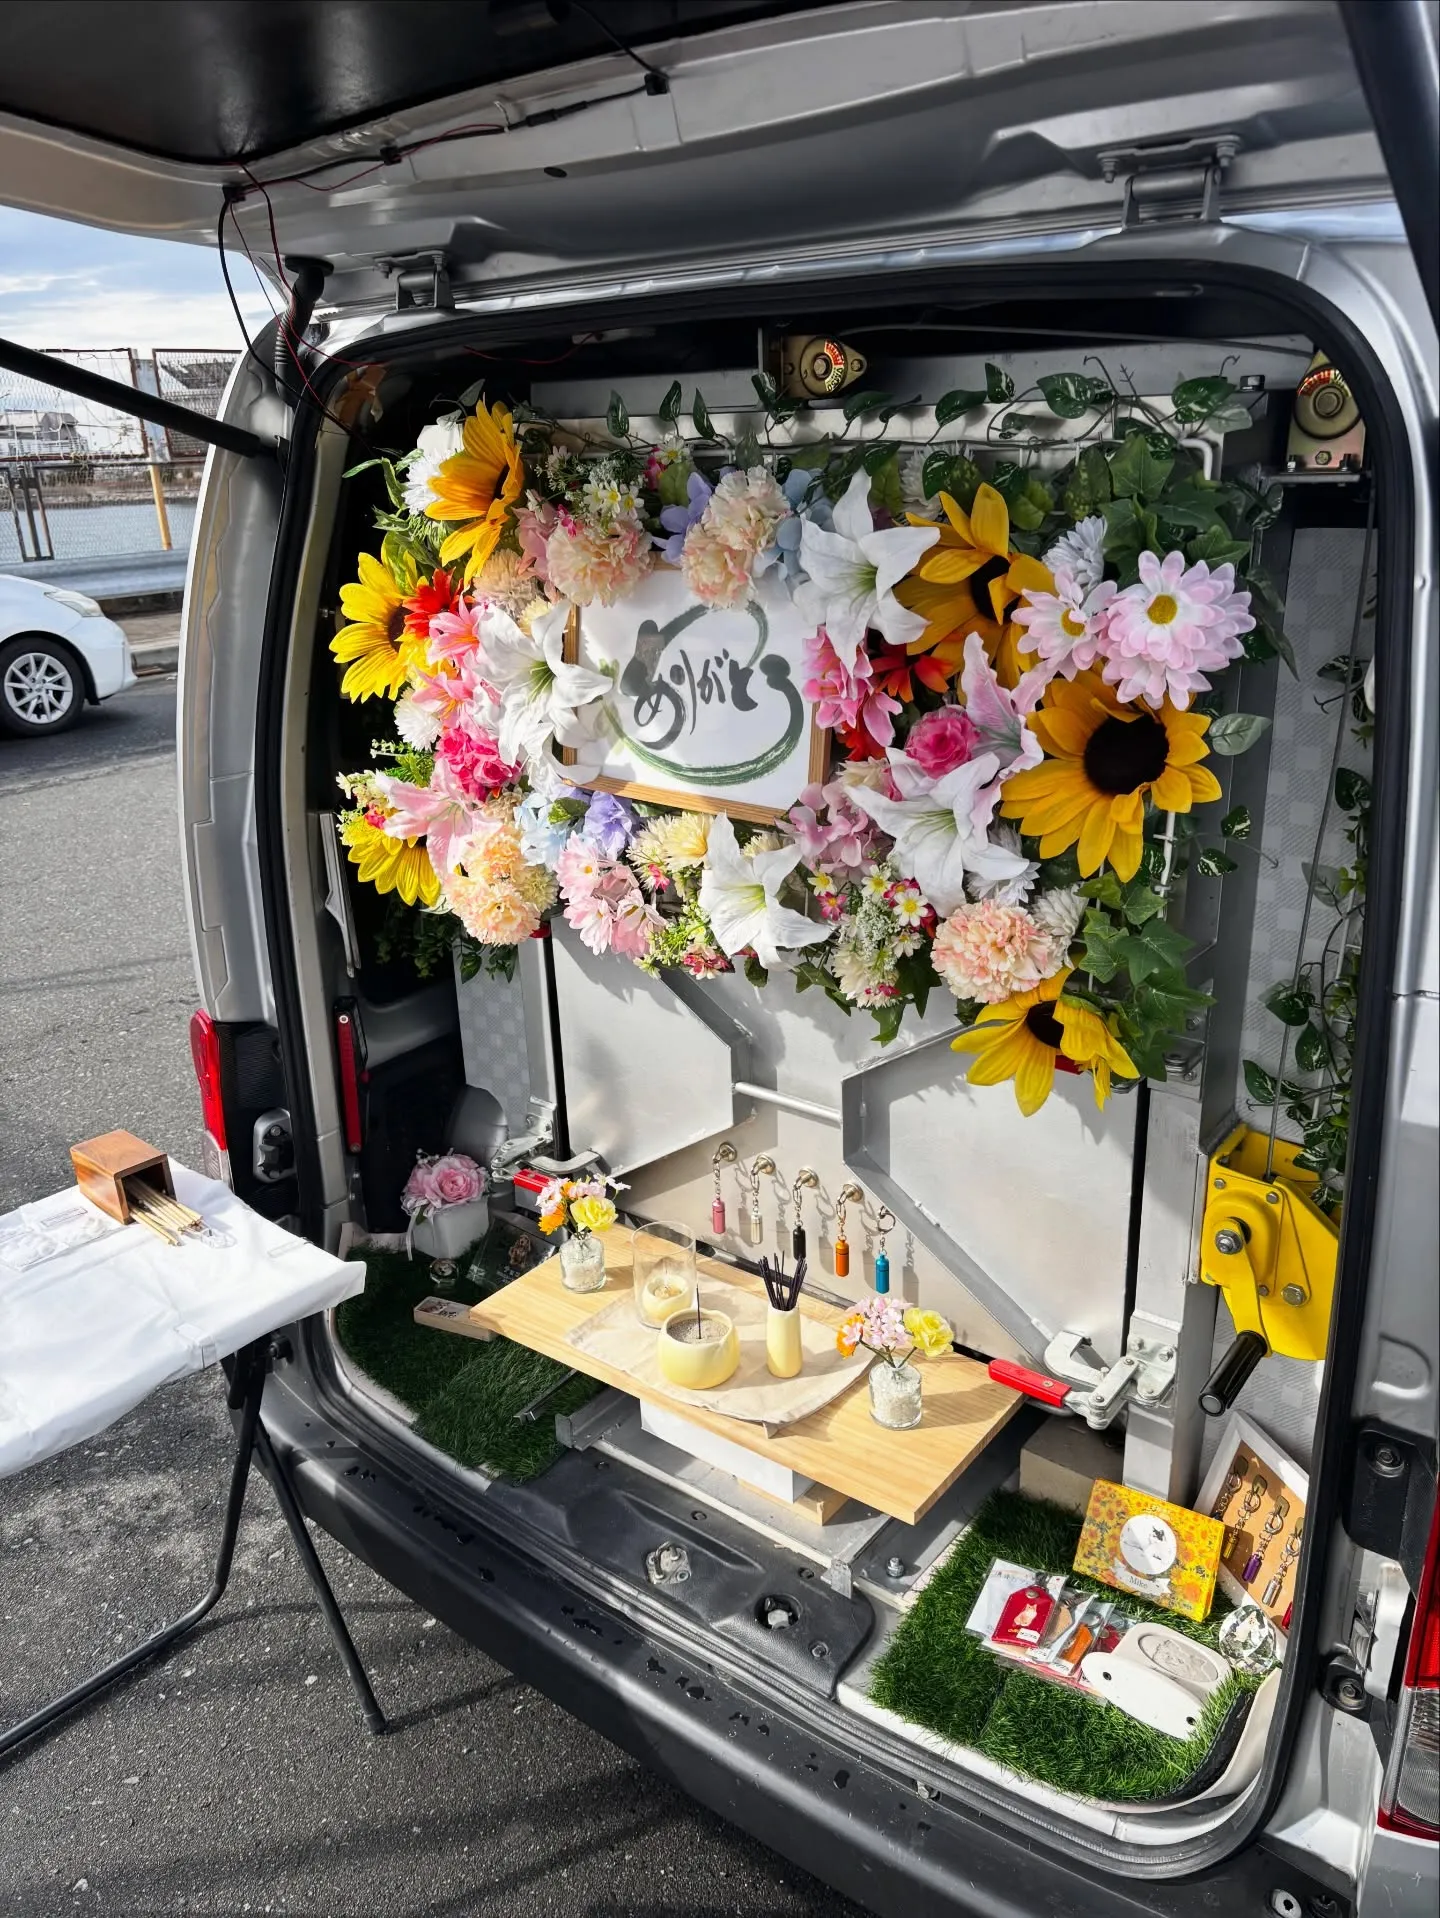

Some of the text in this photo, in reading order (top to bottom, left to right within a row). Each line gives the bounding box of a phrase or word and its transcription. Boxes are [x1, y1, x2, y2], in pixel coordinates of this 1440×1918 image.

[604, 601, 804, 785] ありがとう
